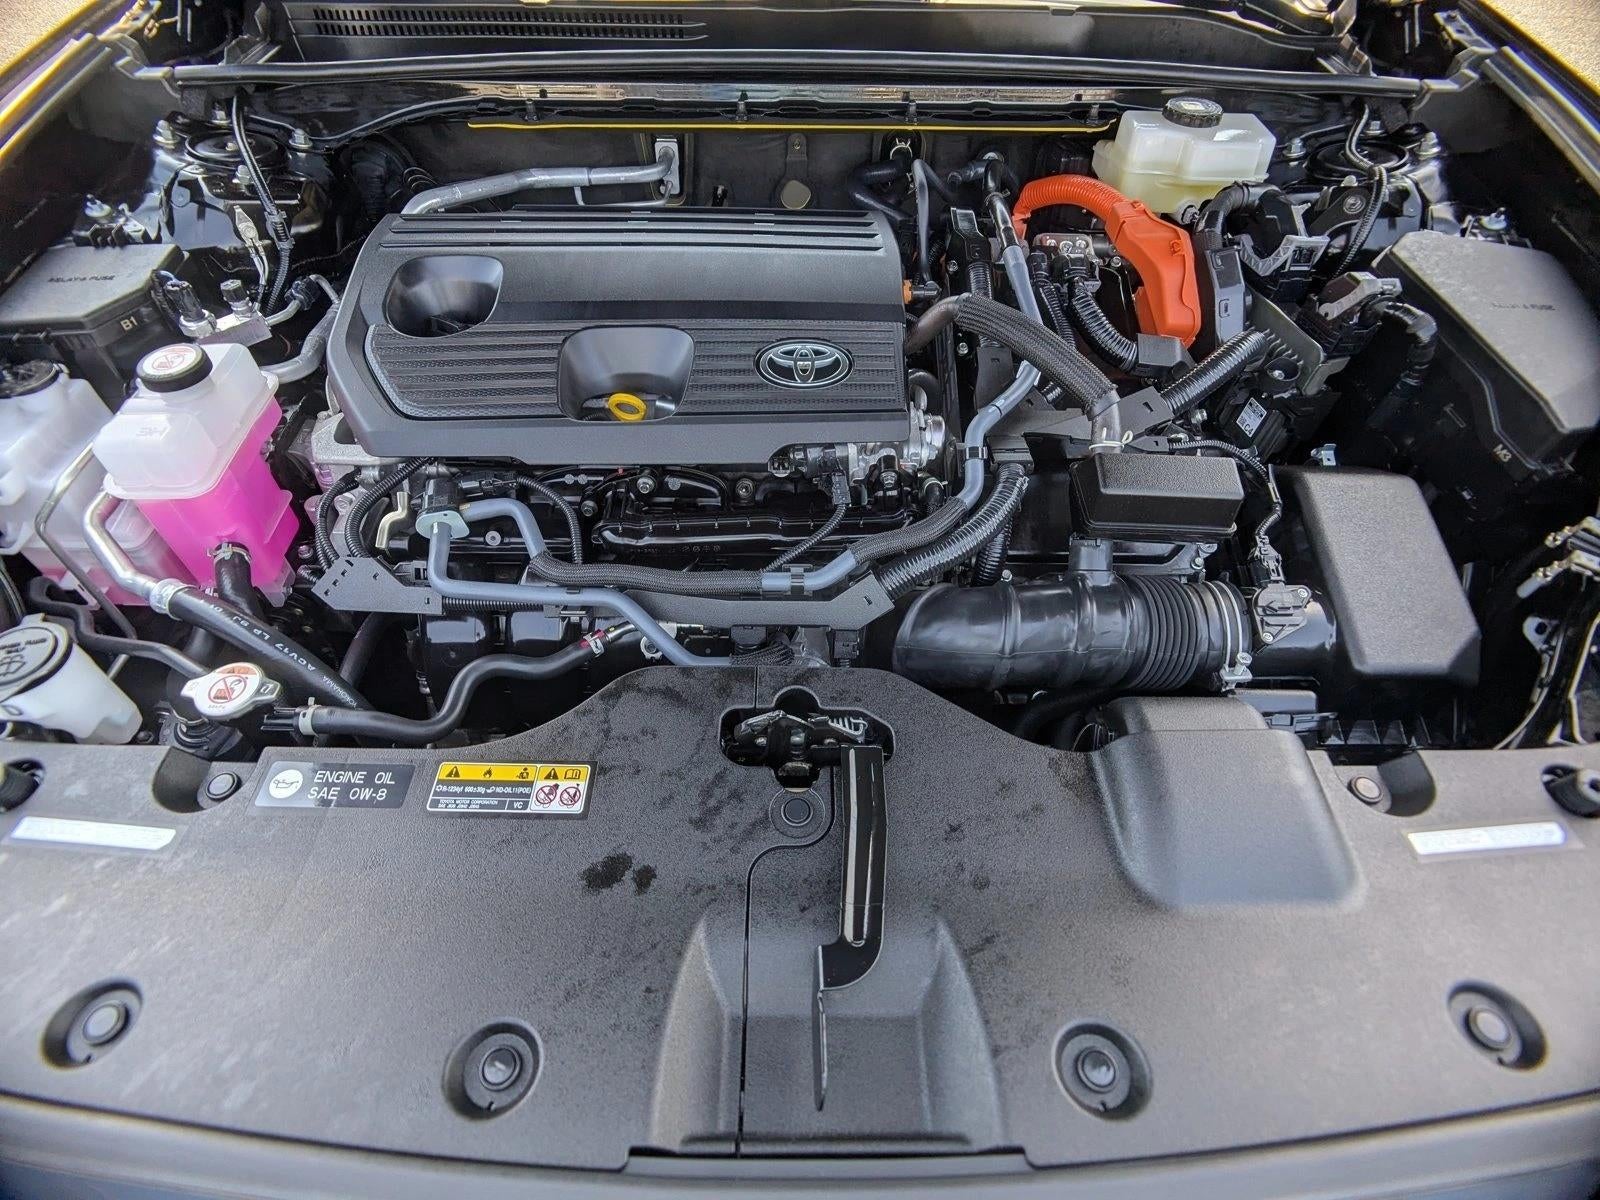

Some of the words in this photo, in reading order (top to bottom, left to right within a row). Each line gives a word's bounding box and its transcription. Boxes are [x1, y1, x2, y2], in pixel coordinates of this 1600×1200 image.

[120, 316, 138, 331] B1
[252, 628, 271, 641] LP
[274, 643, 316, 671] ACV17
[322, 674, 358, 709] YOKOHAMA
[313, 770, 367, 784] ENGINE
[374, 771, 396, 785] OIL
[307, 787, 341, 801] SAE
[513, 801, 524, 809] VC
